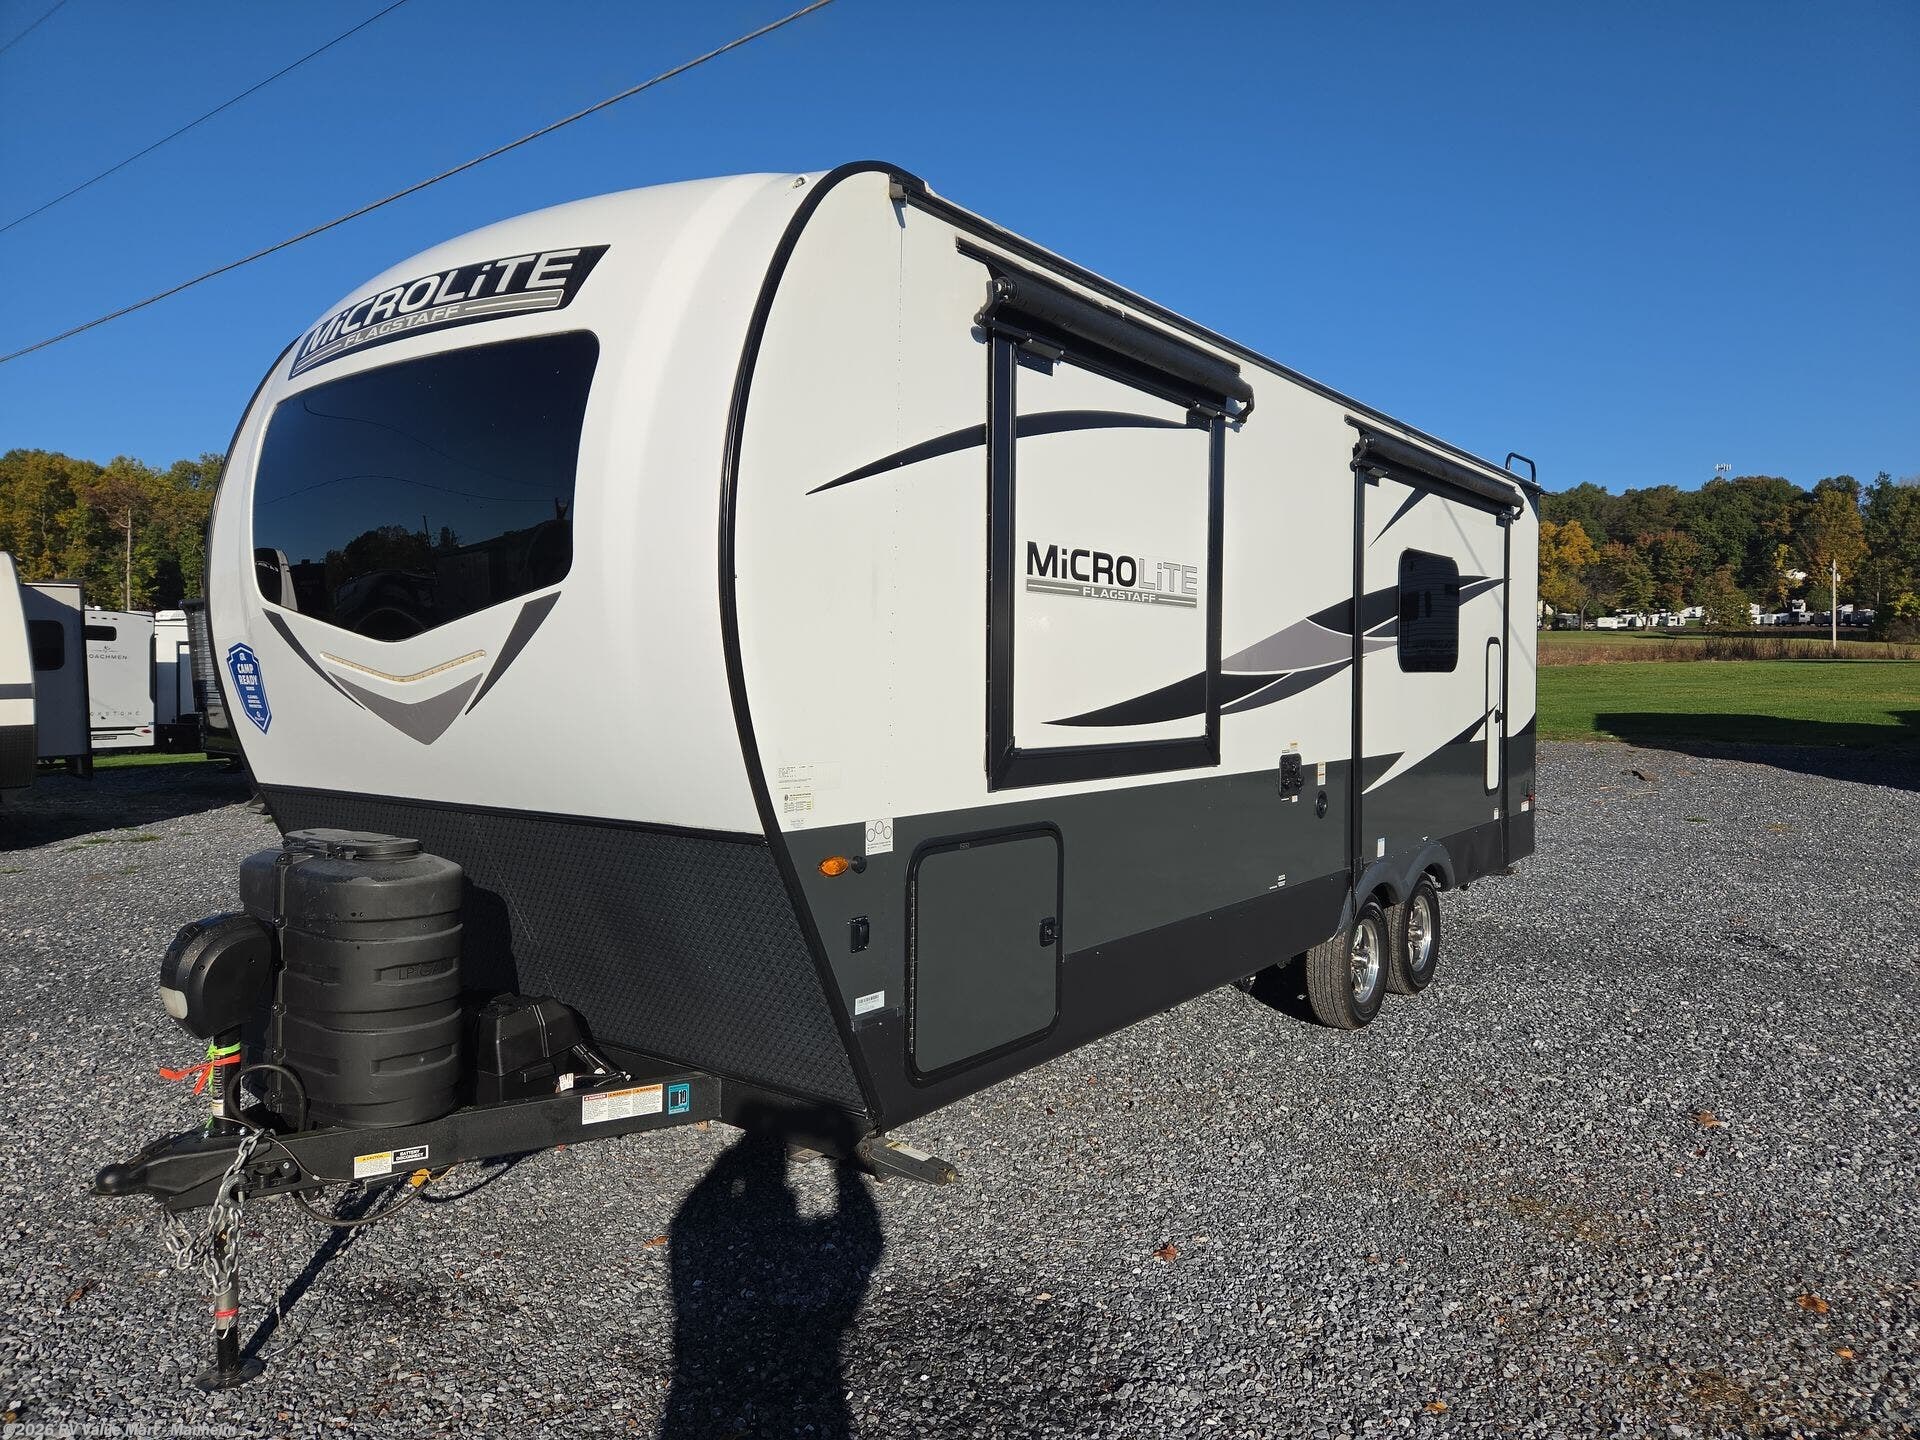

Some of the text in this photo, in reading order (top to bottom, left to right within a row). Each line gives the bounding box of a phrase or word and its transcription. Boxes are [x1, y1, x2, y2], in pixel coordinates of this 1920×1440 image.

[344, 305, 461, 347] FLAGSTAFF
[1027, 540, 1198, 595] MiCROLiTE
[1082, 586, 1157, 603] FLAGSTAFF
[237, 663, 254, 674] CAMP
[238, 674, 258, 686] READY
